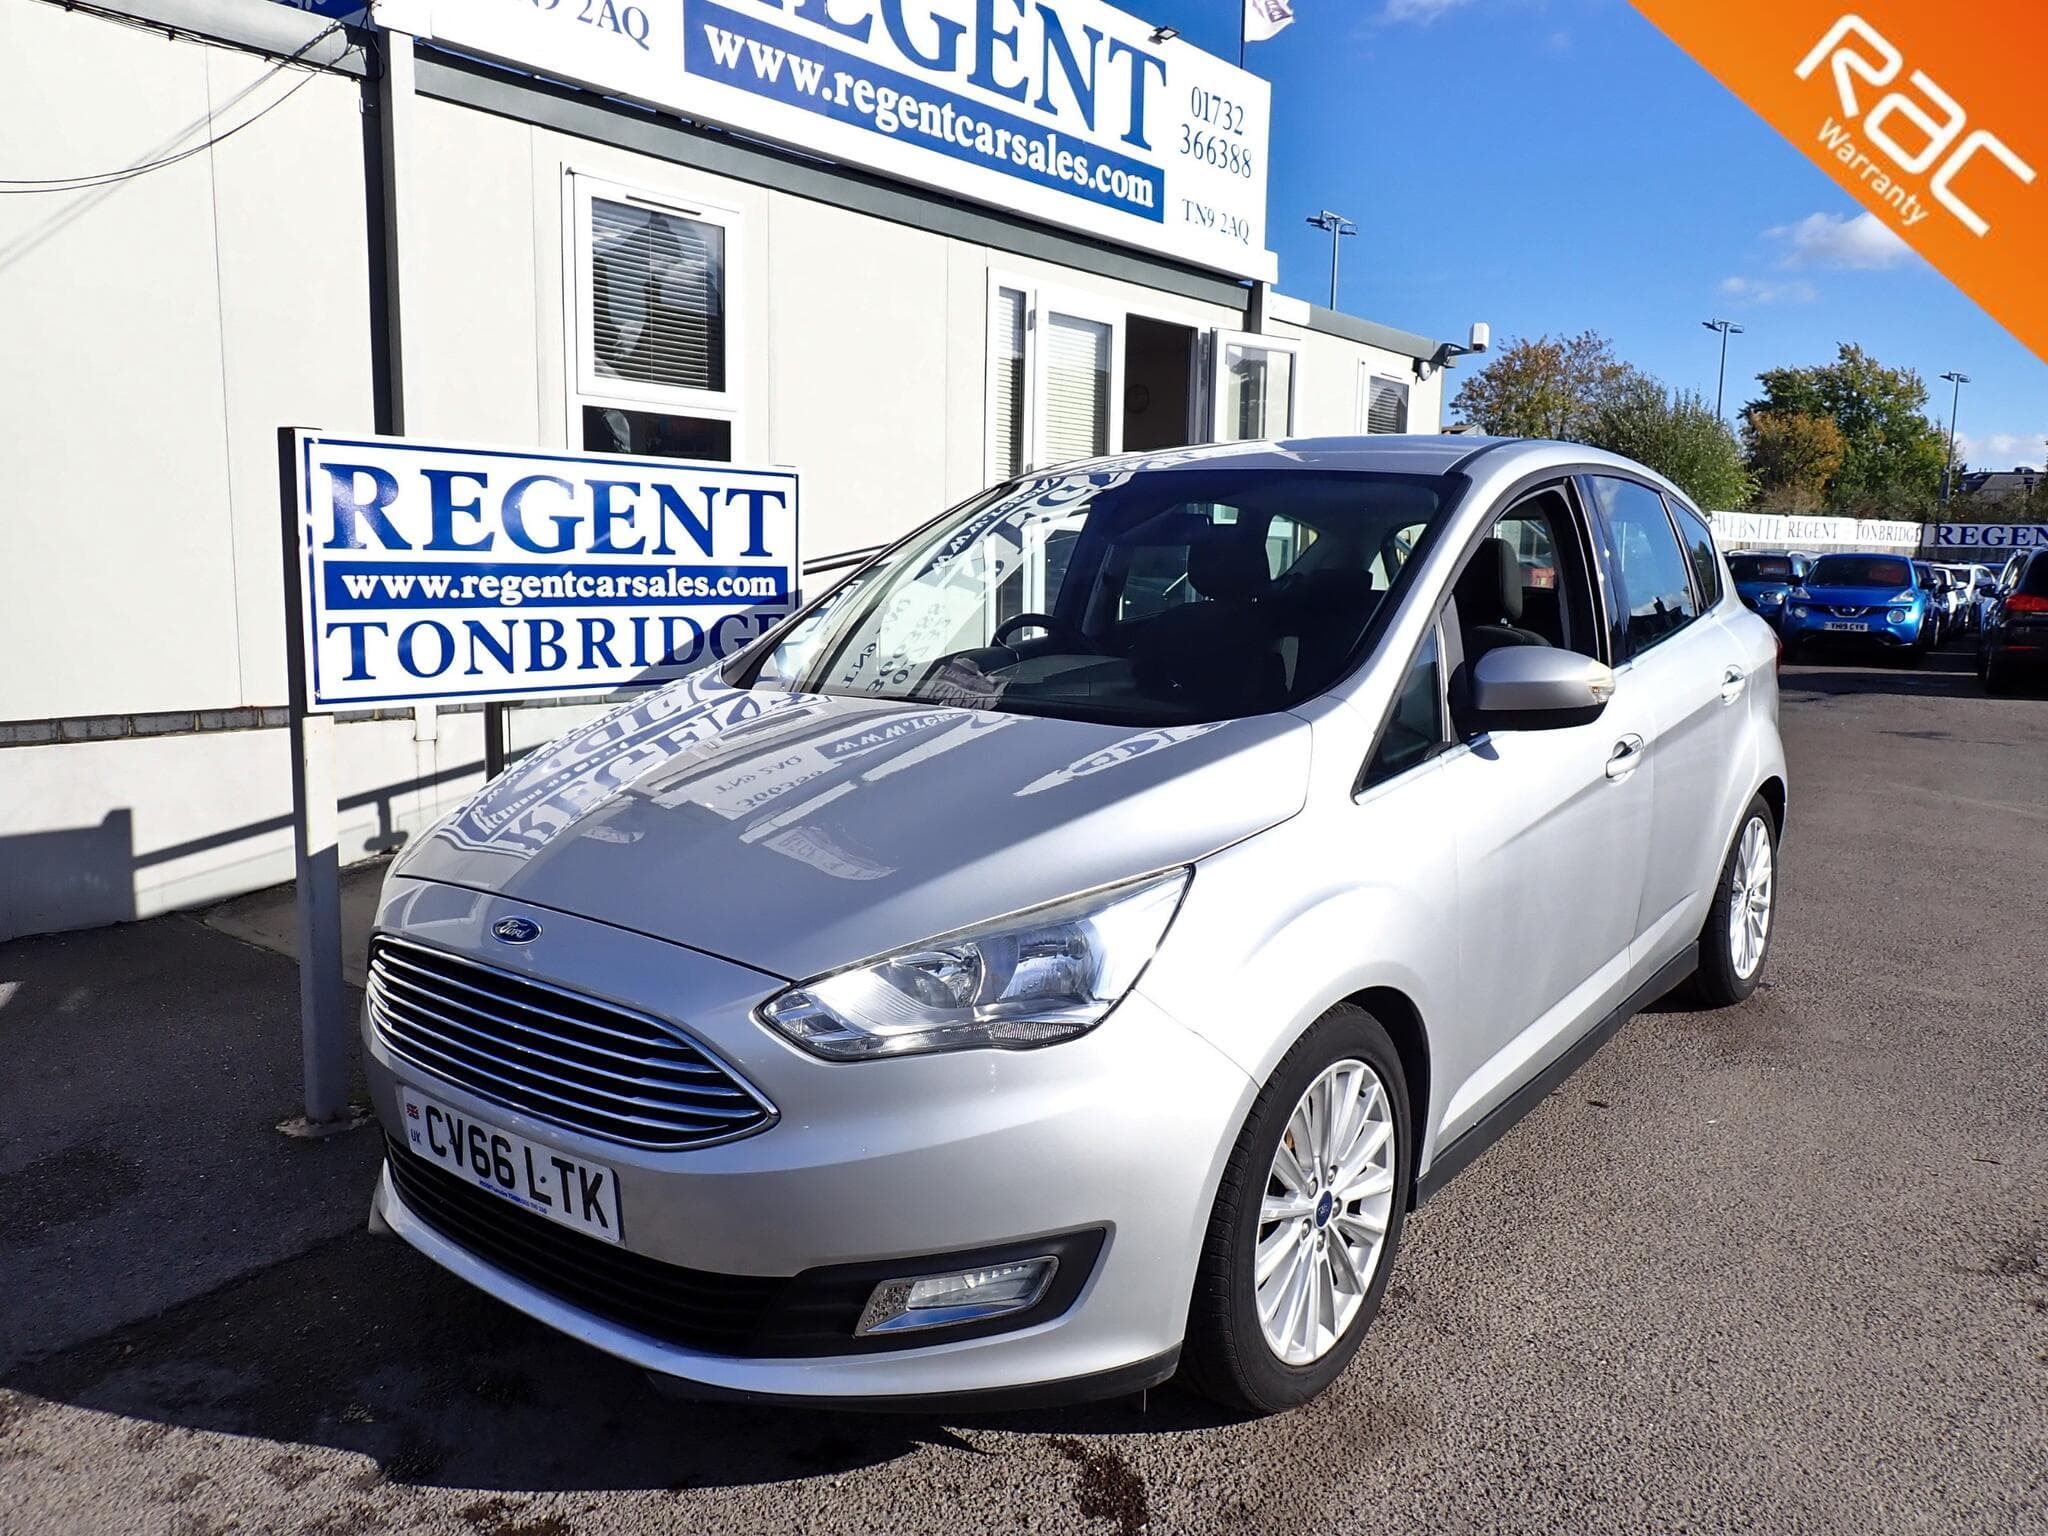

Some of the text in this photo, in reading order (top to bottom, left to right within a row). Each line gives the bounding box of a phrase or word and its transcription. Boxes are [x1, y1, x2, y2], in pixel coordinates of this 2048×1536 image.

[704, 24, 1154, 208] www.regentcarsales.com
[1191, 86, 1244, 136] 01732
[1180, 123, 1251, 178] 366388
[1182, 198, 1250, 245] TN9 2AQ
[320, 462, 787, 557] REGENT
[1787, 520, 1839, 540] REGENT
[1855, 520, 1921, 542] TONBRIDGE
[341, 567, 777, 606] www.regentcarsales.com
[411, 1128, 421, 1145] UK
[426, 1105, 515, 1189] CV66
[524, 1146, 608, 1228] LTK
